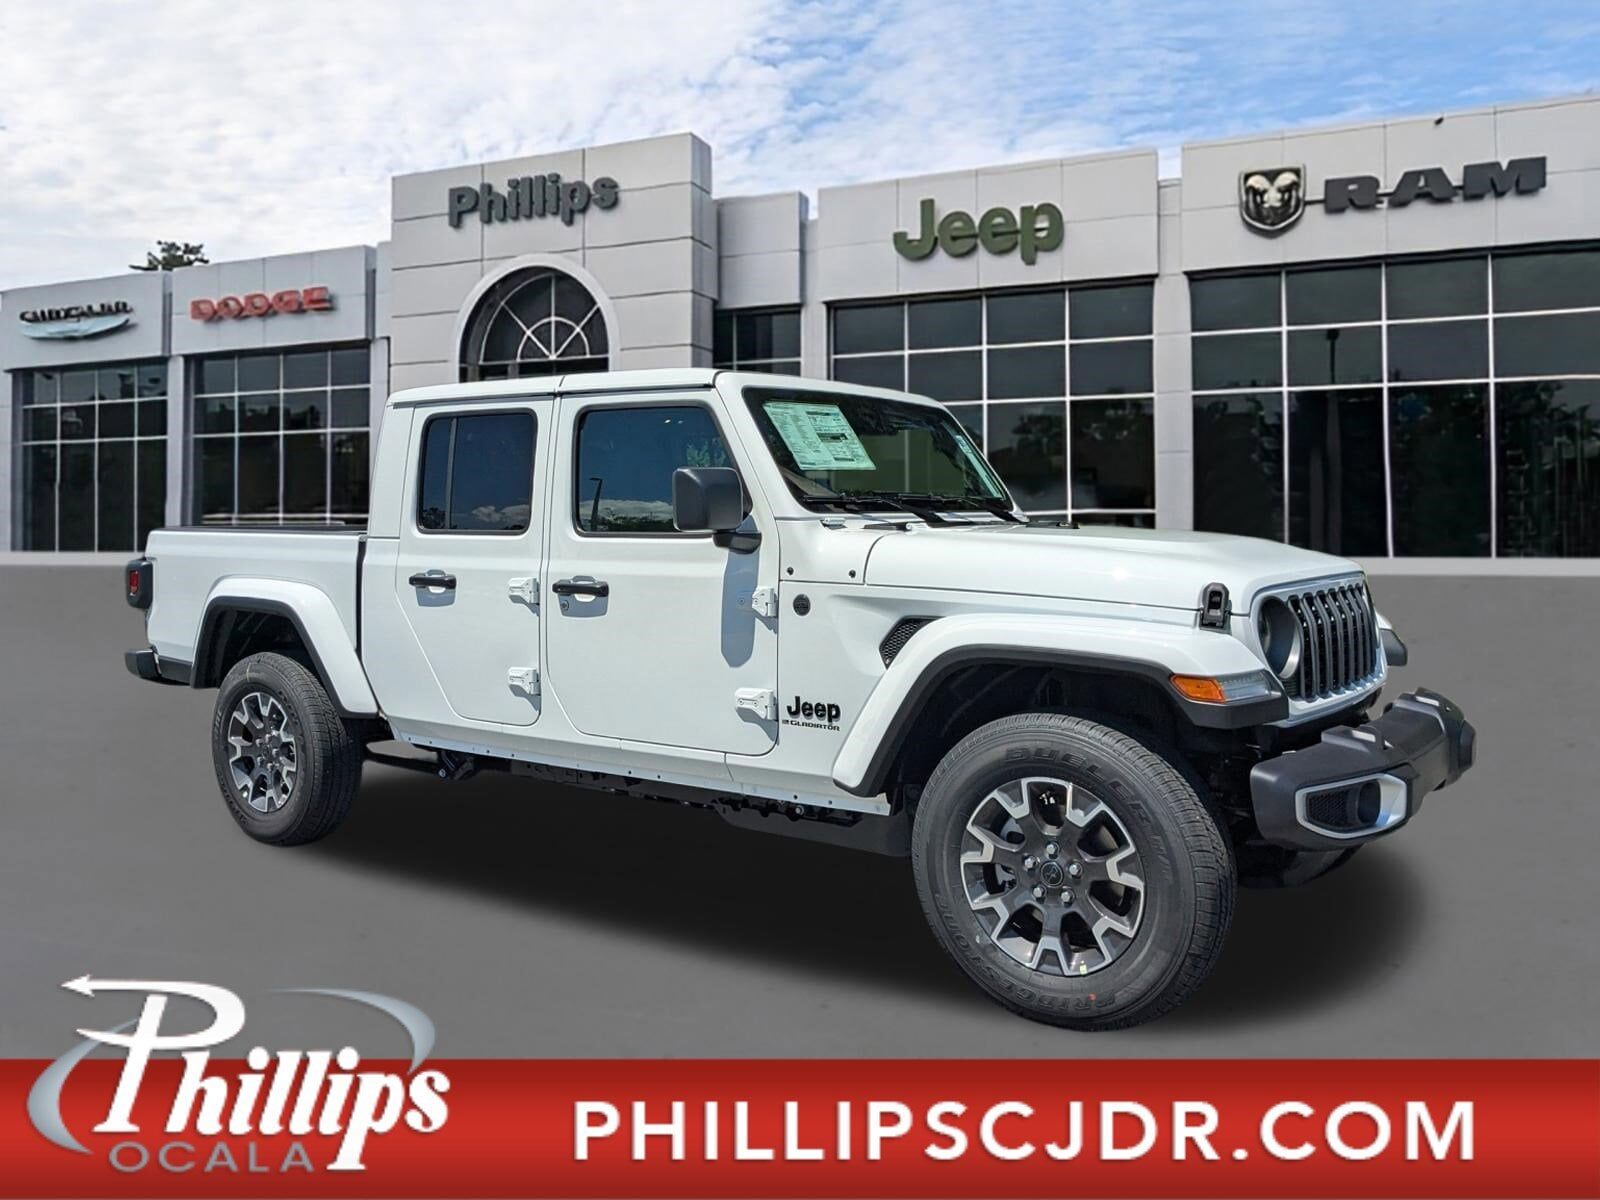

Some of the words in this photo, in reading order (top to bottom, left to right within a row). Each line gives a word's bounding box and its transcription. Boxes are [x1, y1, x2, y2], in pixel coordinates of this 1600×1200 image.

[448, 172, 619, 228] Phillips
[1324, 156, 1547, 214] RAM
[893, 198, 1064, 265] Jeep
[190, 285, 333, 321] DODGE
[787, 696, 841, 723] Jeep
[790, 720, 841, 732] GLADIATOR
